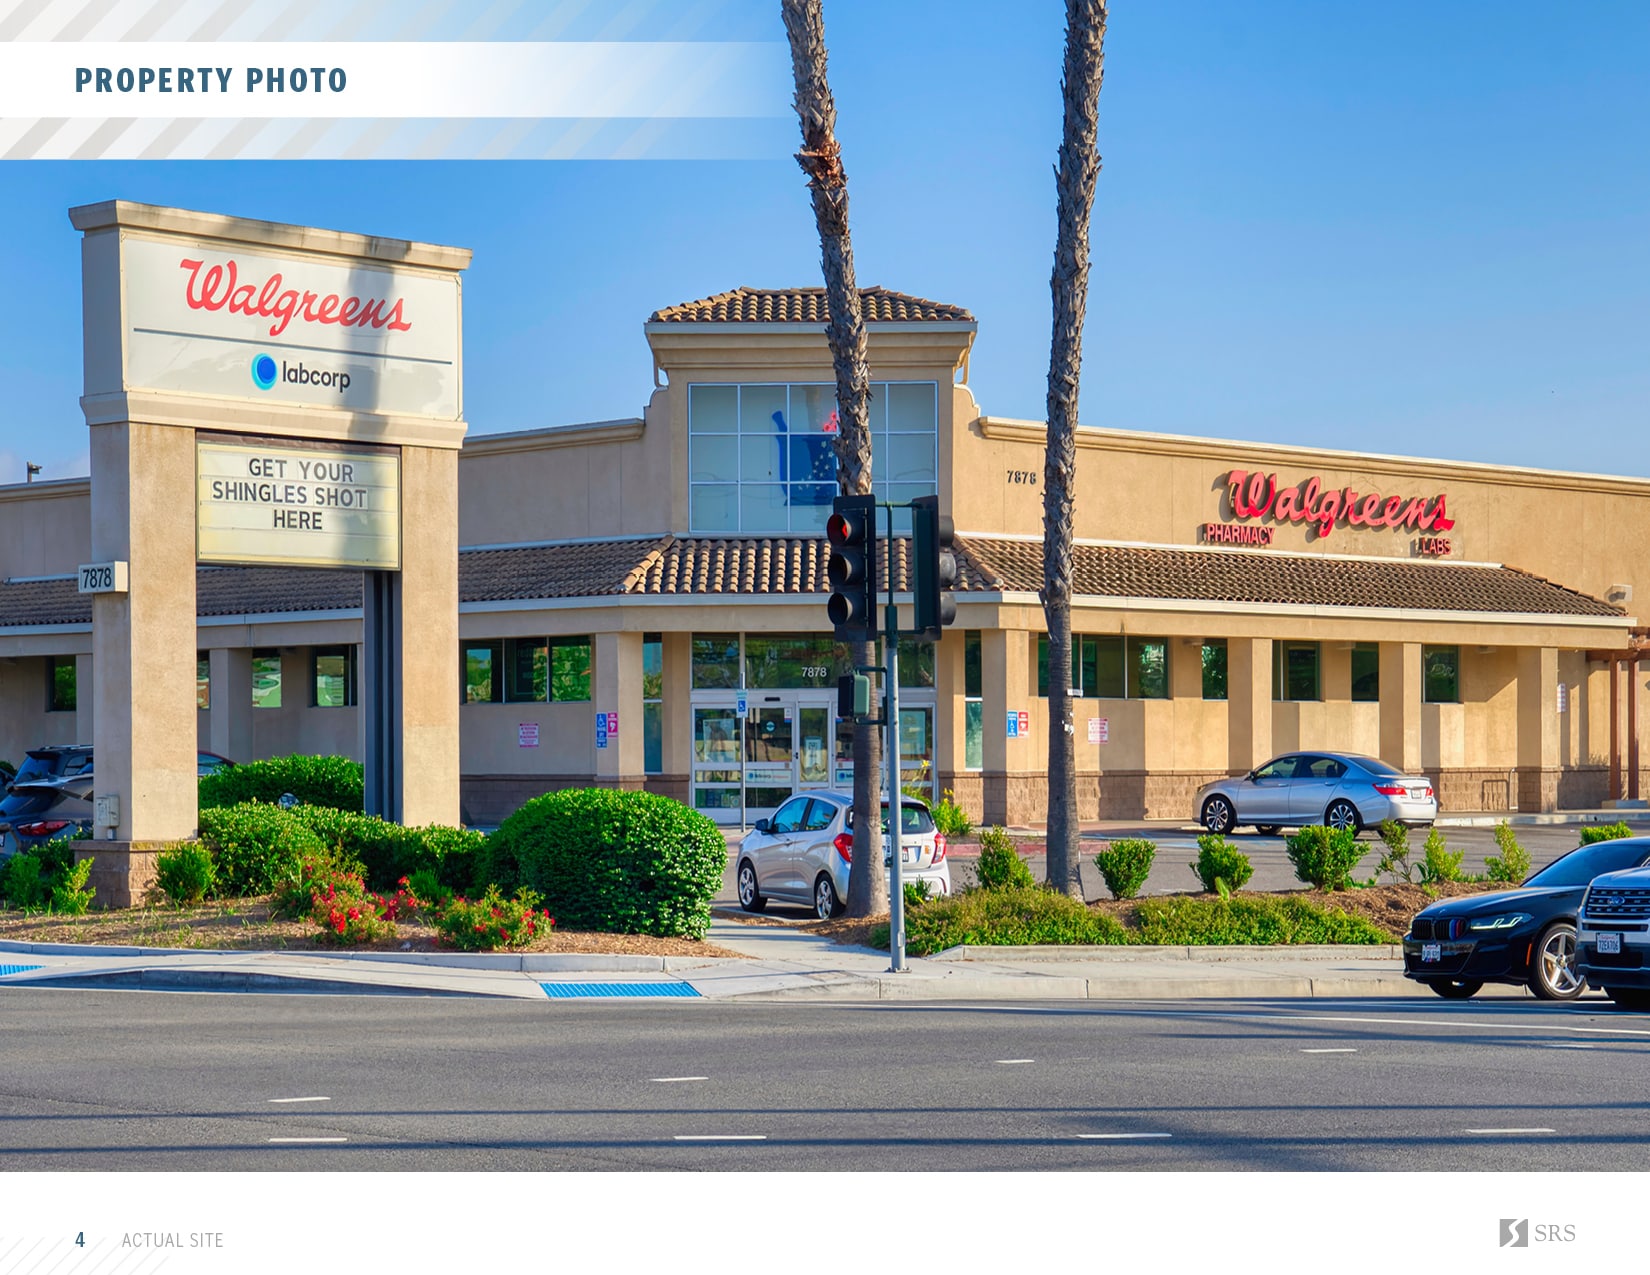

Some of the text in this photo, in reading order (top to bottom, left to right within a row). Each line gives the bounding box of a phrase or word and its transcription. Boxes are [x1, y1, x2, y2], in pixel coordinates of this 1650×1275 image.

[180, 259, 412, 336] Walgreens
[282, 360, 351, 393] labcorp
[248, 458, 354, 483] GET YOUR
[1007, 470, 1037, 485] 7878
[212, 480, 367, 508] SHINGLES SHOT
[1229, 470, 1455, 539] Walgreens
[273, 509, 323, 530] HERE
[1206, 522, 1276, 545] PHARMACY
[1421, 537, 1452, 556] LABS
[82, 567, 112, 589] 7878
[801, 666, 828, 678] 7878
